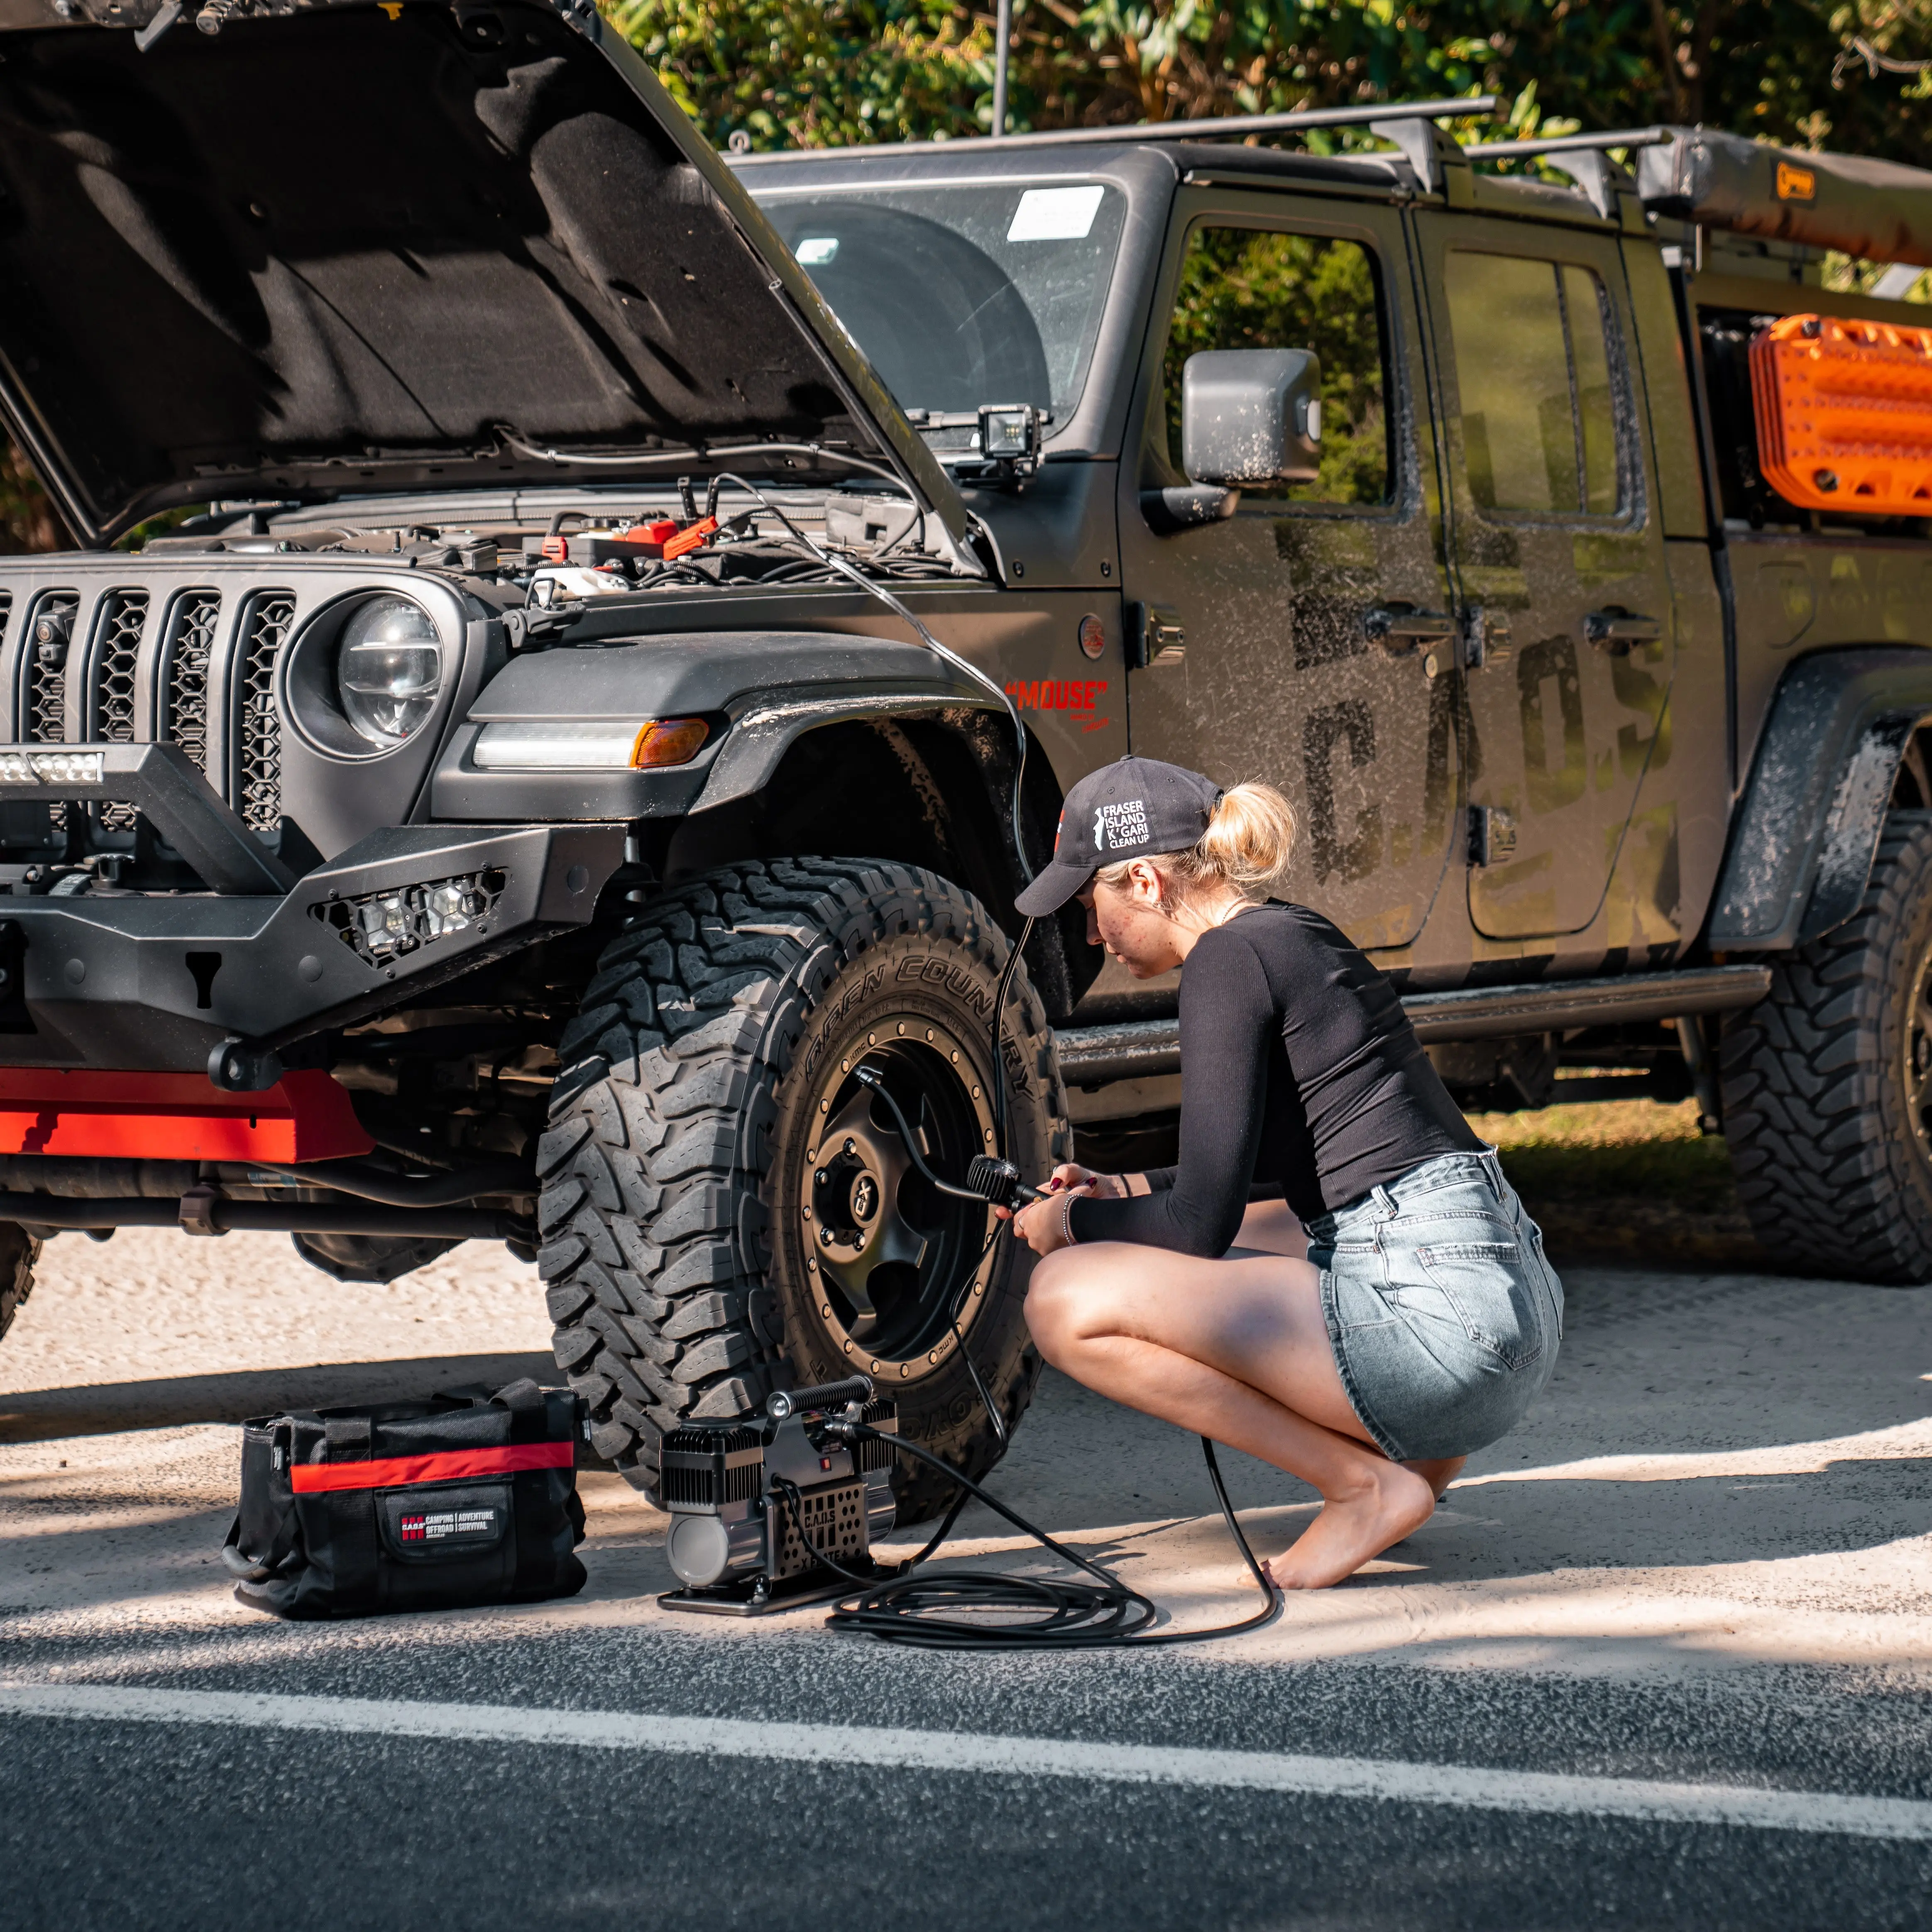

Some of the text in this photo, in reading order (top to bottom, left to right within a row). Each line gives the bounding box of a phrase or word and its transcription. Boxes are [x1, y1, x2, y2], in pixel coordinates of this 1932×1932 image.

[1103, 800, 1144, 818] FRASER
[1105, 812, 1146, 829] ISLAND
[1110, 834, 1149, 849] CLEAN UP
[807, 964, 885, 1080] OPEN
[426, 1511, 494, 1525] CAMPING ADVENTURE
[426, 1521, 487, 1534] OFFROAD SURVIVAL
